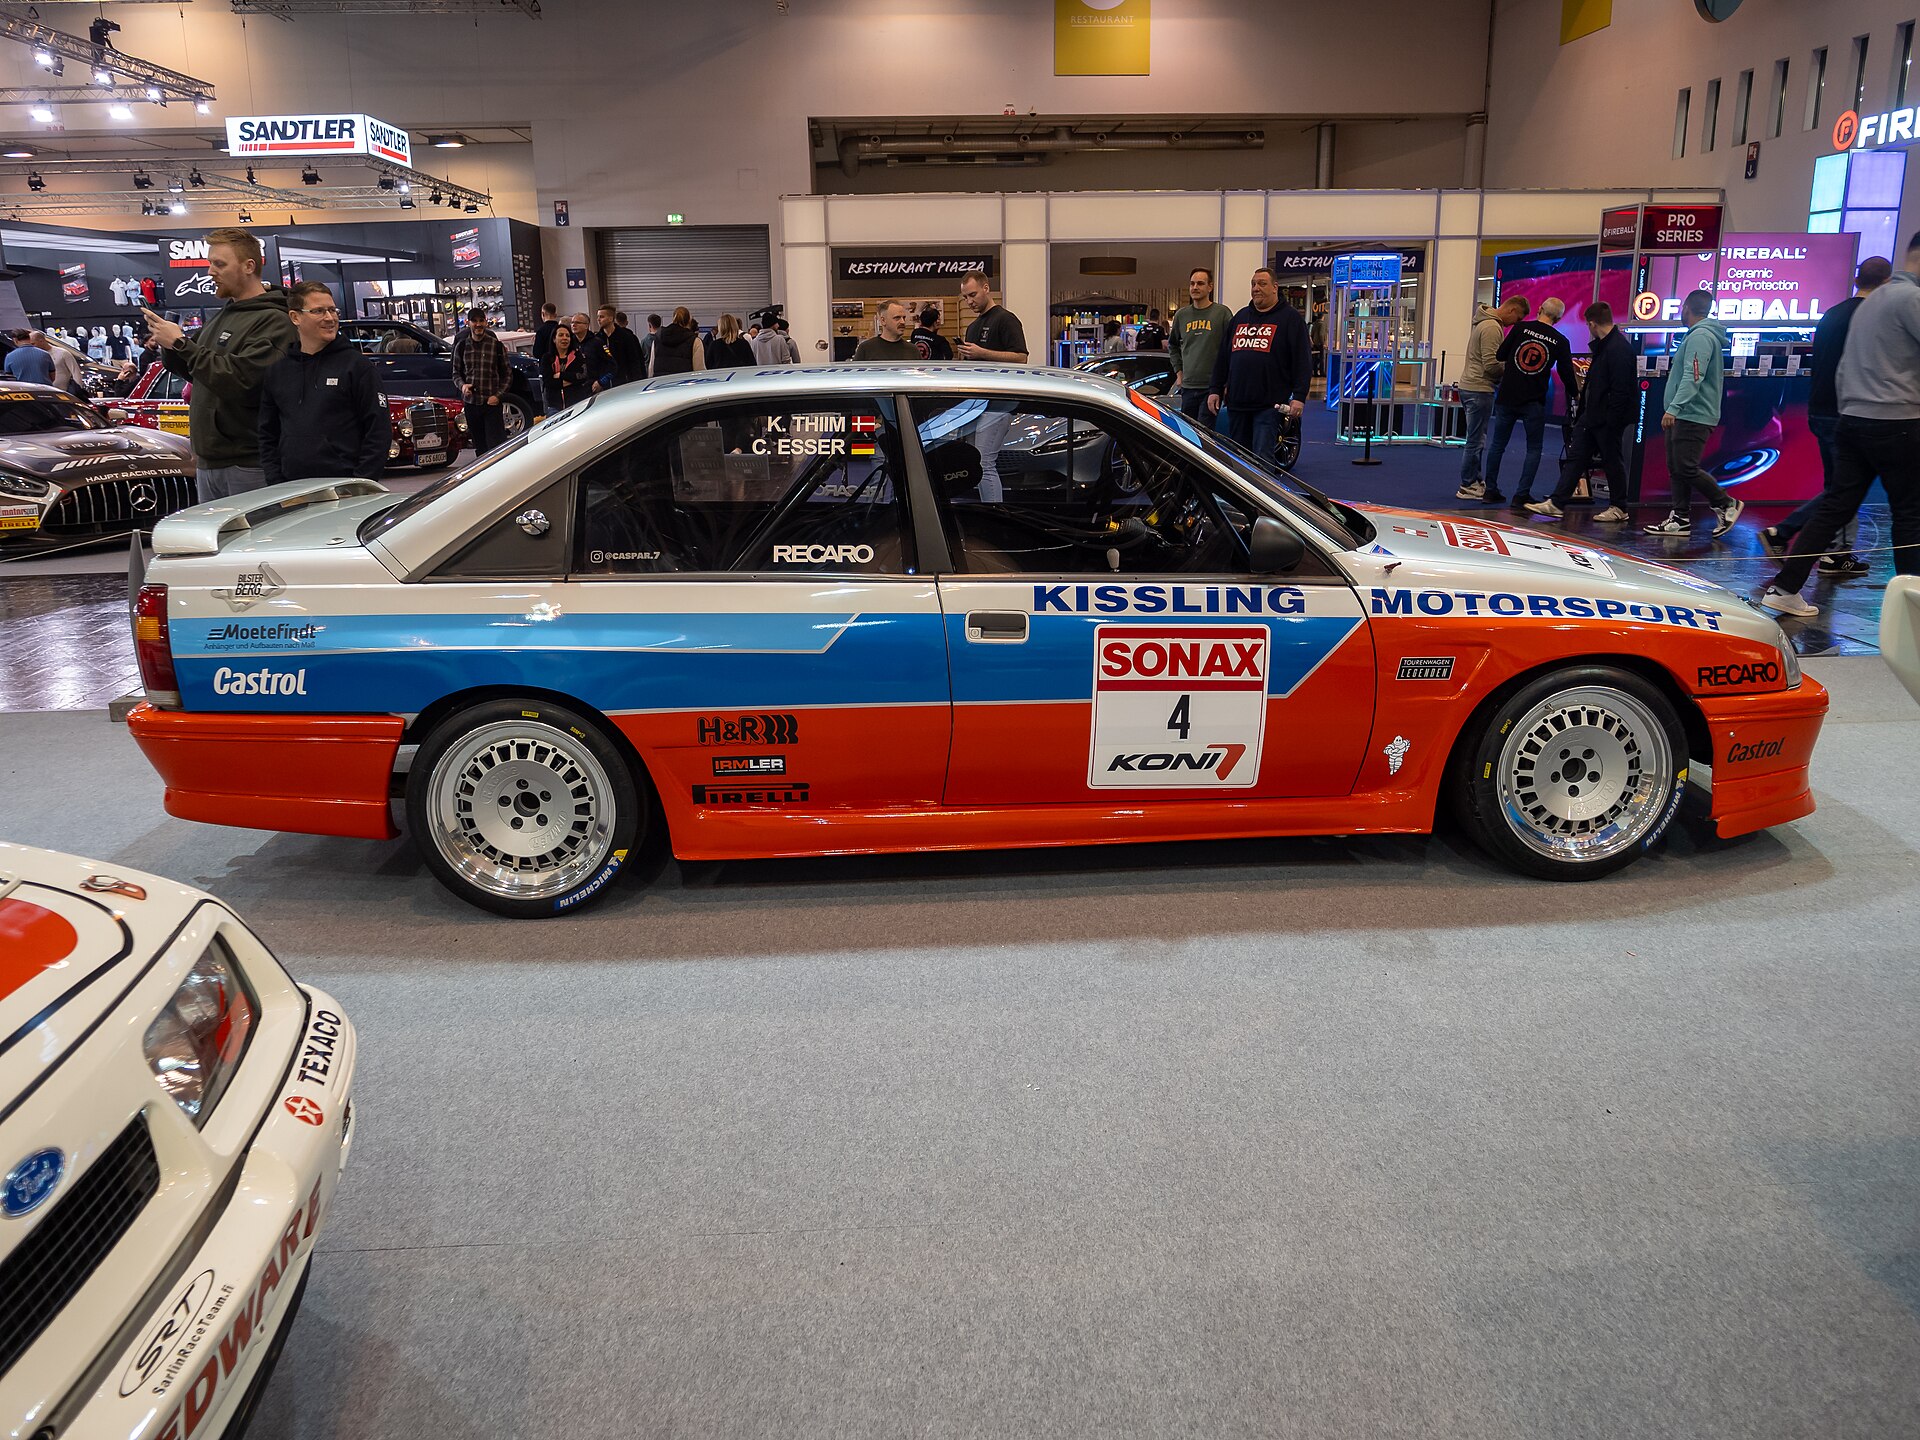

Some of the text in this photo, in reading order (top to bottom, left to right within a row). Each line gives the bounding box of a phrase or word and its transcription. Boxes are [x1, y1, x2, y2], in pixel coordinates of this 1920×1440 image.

[1071, 15, 1134, 24] RESTAURANT
[239, 119, 355, 141] SANDTLER
[369, 121, 407, 153] SANDTLER
[1667, 214, 1696, 227] PRO
[1607, 226, 1635, 236] FIREBALL
[1656, 230, 1704, 242] SERIES
[848, 260, 985, 274] RESTAURANT PIAZZA
[1727, 267, 1773, 279] Ceramic
[1742, 280, 1799, 292] Protection
[1185, 319, 1212, 333] PUMA
[1235, 325, 1273, 337] JACK&
[1233, 337, 1269, 349] JONES
[1523, 328, 1558, 345] FIREBALL
[768, 415, 846, 432] K. THIIM
[752, 438, 846, 455] C. ESSER
[99, 453, 182, 463] AMG
[85, 472, 120, 483] HAUPT
[121, 469, 158, 478] RACING
[773, 544, 874, 563] RECARO
[237, 573, 264, 583] BILSTER
[235, 583, 262, 596] BERG
[1034, 585, 1306, 614] KISSLING
[1371, 588, 1723, 631] MOTORSPORT
[223, 623, 317, 640] Moetefindt
[204, 640, 316, 652] Anhänger und Aufbauten nach Maß
[1101, 641, 1264, 677] SONAX
[213, 667, 307, 696] Castrol
[1400, 668, 1448, 678] LEGENDEN
[1698, 661, 1779, 687] RECARO
[1167, 694, 1191, 739] 4
[1727, 737, 1786, 763] Castrol
[715, 758, 784, 770] IRMLER
[1106, 752, 1222, 772] KONI
[692, 782, 810, 806] PIRELLI
[1644, 791, 1682, 847] MICHELIN
[558, 866, 614, 908] MICHELIN
[299, 1009, 342, 1087] TEXACO
[136, 1283, 195, 1382] SRT
[152, 1284, 235, 1397] SarlinRaceTeam.fi
